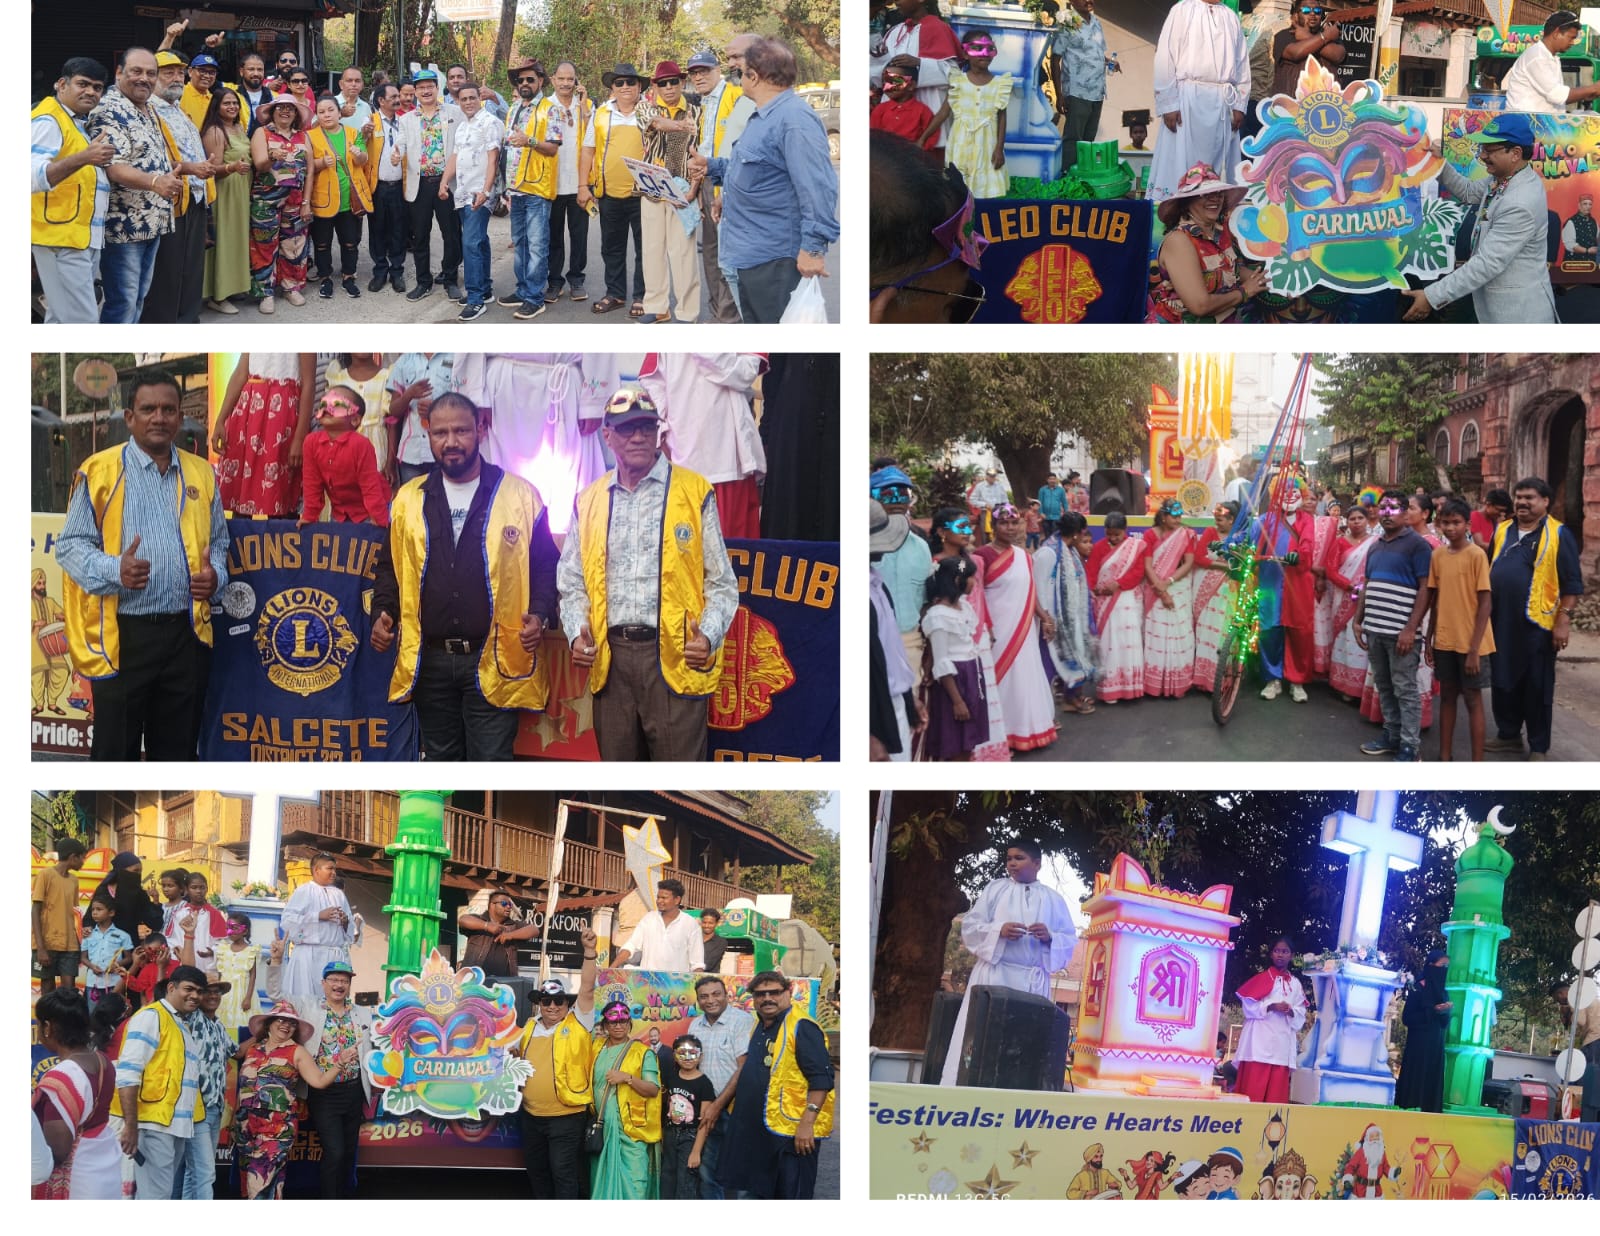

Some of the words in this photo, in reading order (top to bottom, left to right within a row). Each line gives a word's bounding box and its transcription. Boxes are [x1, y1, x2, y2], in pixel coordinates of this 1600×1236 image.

[1341, 24, 1376, 43] KFORD
[1304, 93, 1341, 107] LIONS
[1317, 109, 1336, 129] L
[1531, 153, 1599, 178] RNAVAL
[981, 205, 1041, 244] LEO
[1050, 204, 1131, 244] CLUB
[1301, 205, 1414, 235] CARNAVAL
[1046, 250, 1063, 322] LEO
[227, 532, 302, 576] LIONS
[269, 590, 335, 613] LIONS
[291, 619, 321, 659] L
[272, 668, 338, 689] INTERNATIONAL
[31, 721, 84, 748] Pride:
[222, 712, 389, 750] SALCETE
[526, 909, 588, 932] ROKFORD
[1149, 960, 1188, 1008] श्री
[413, 1059, 495, 1077] CARNAVAL
[369, 1120, 423, 1141] 2026
[1014, 1108, 1097, 1130] Where
[1104, 1112, 1183, 1133] Hearts
[1190, 1115, 1242, 1134] Meet
[1528, 1123, 1563, 1147] LIONS
[1550, 1156, 1577, 1170] LIONS
[1556, 1172, 1569, 1195] L
